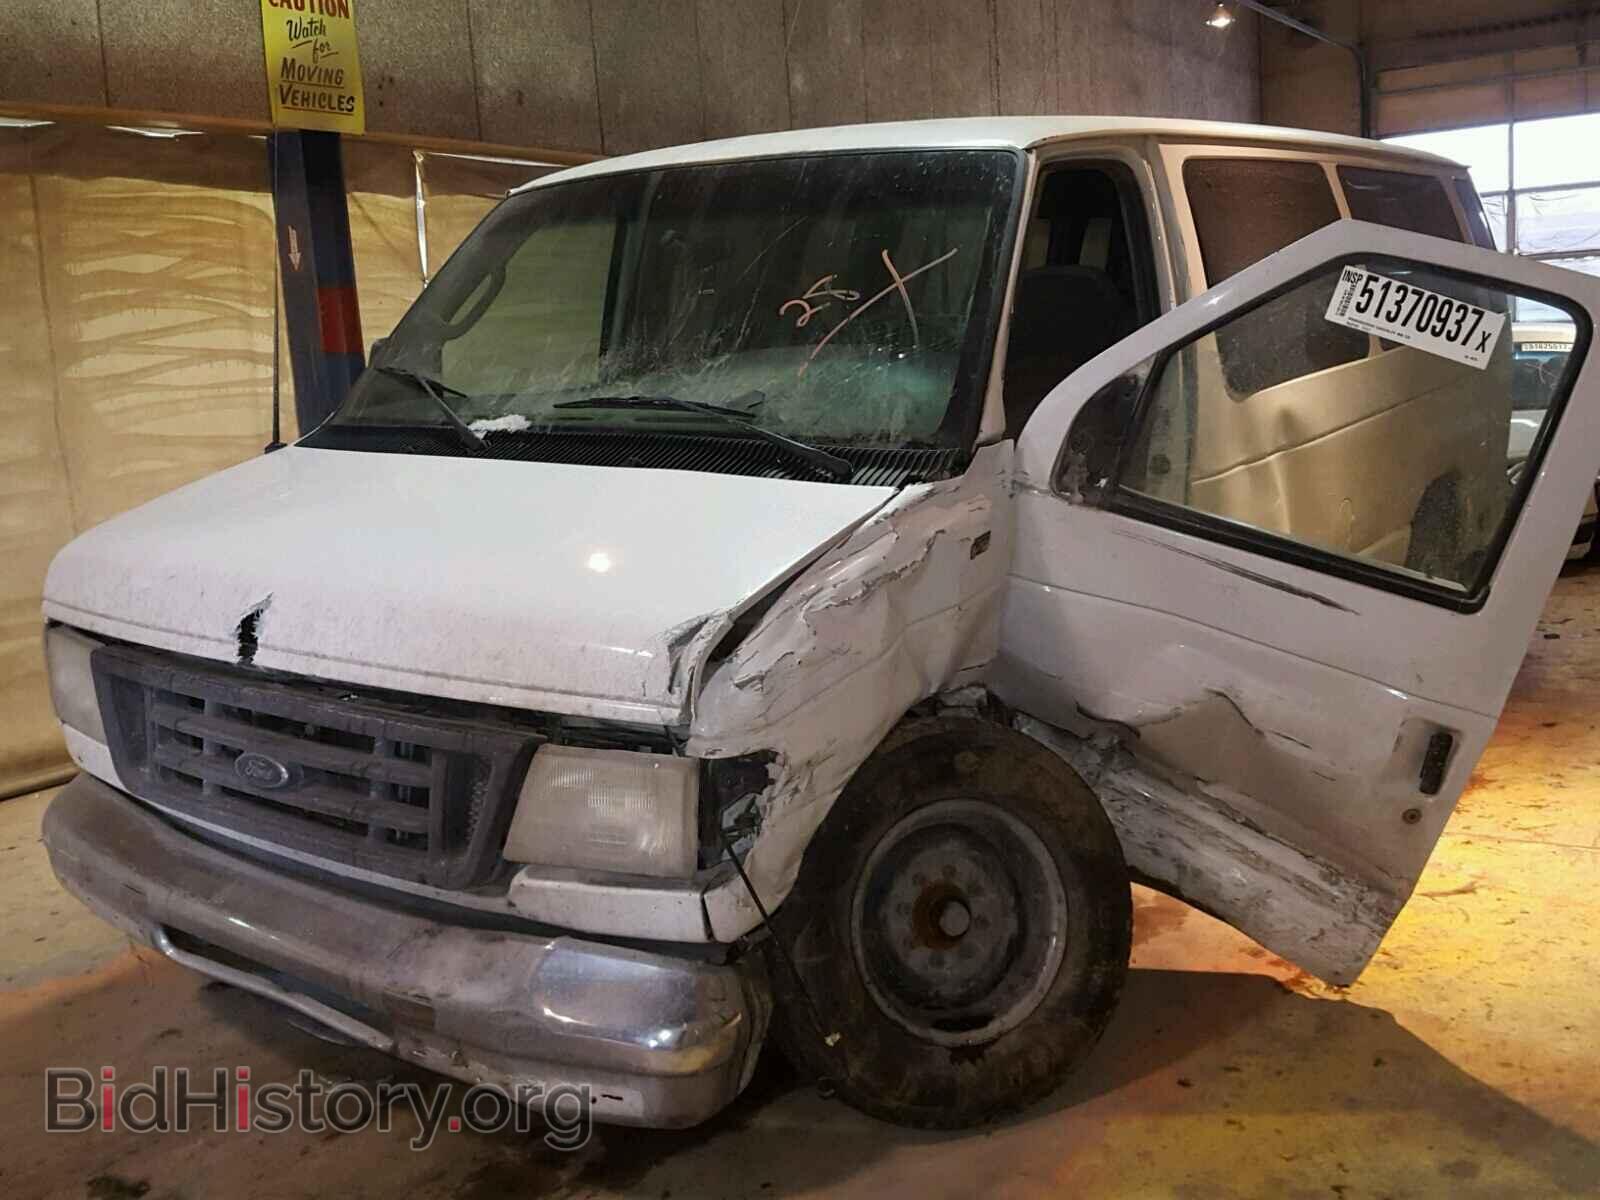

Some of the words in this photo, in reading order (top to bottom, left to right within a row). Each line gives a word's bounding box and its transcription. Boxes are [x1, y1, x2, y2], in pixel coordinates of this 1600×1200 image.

[286, 16, 326, 41] Watch
[312, 39, 331, 64] for
[280, 57, 344, 86] MOVING
[279, 84, 355, 113] VEHICLES
[1342, 269, 1363, 284] INSP
[1355, 274, 1486, 346] 51370937
